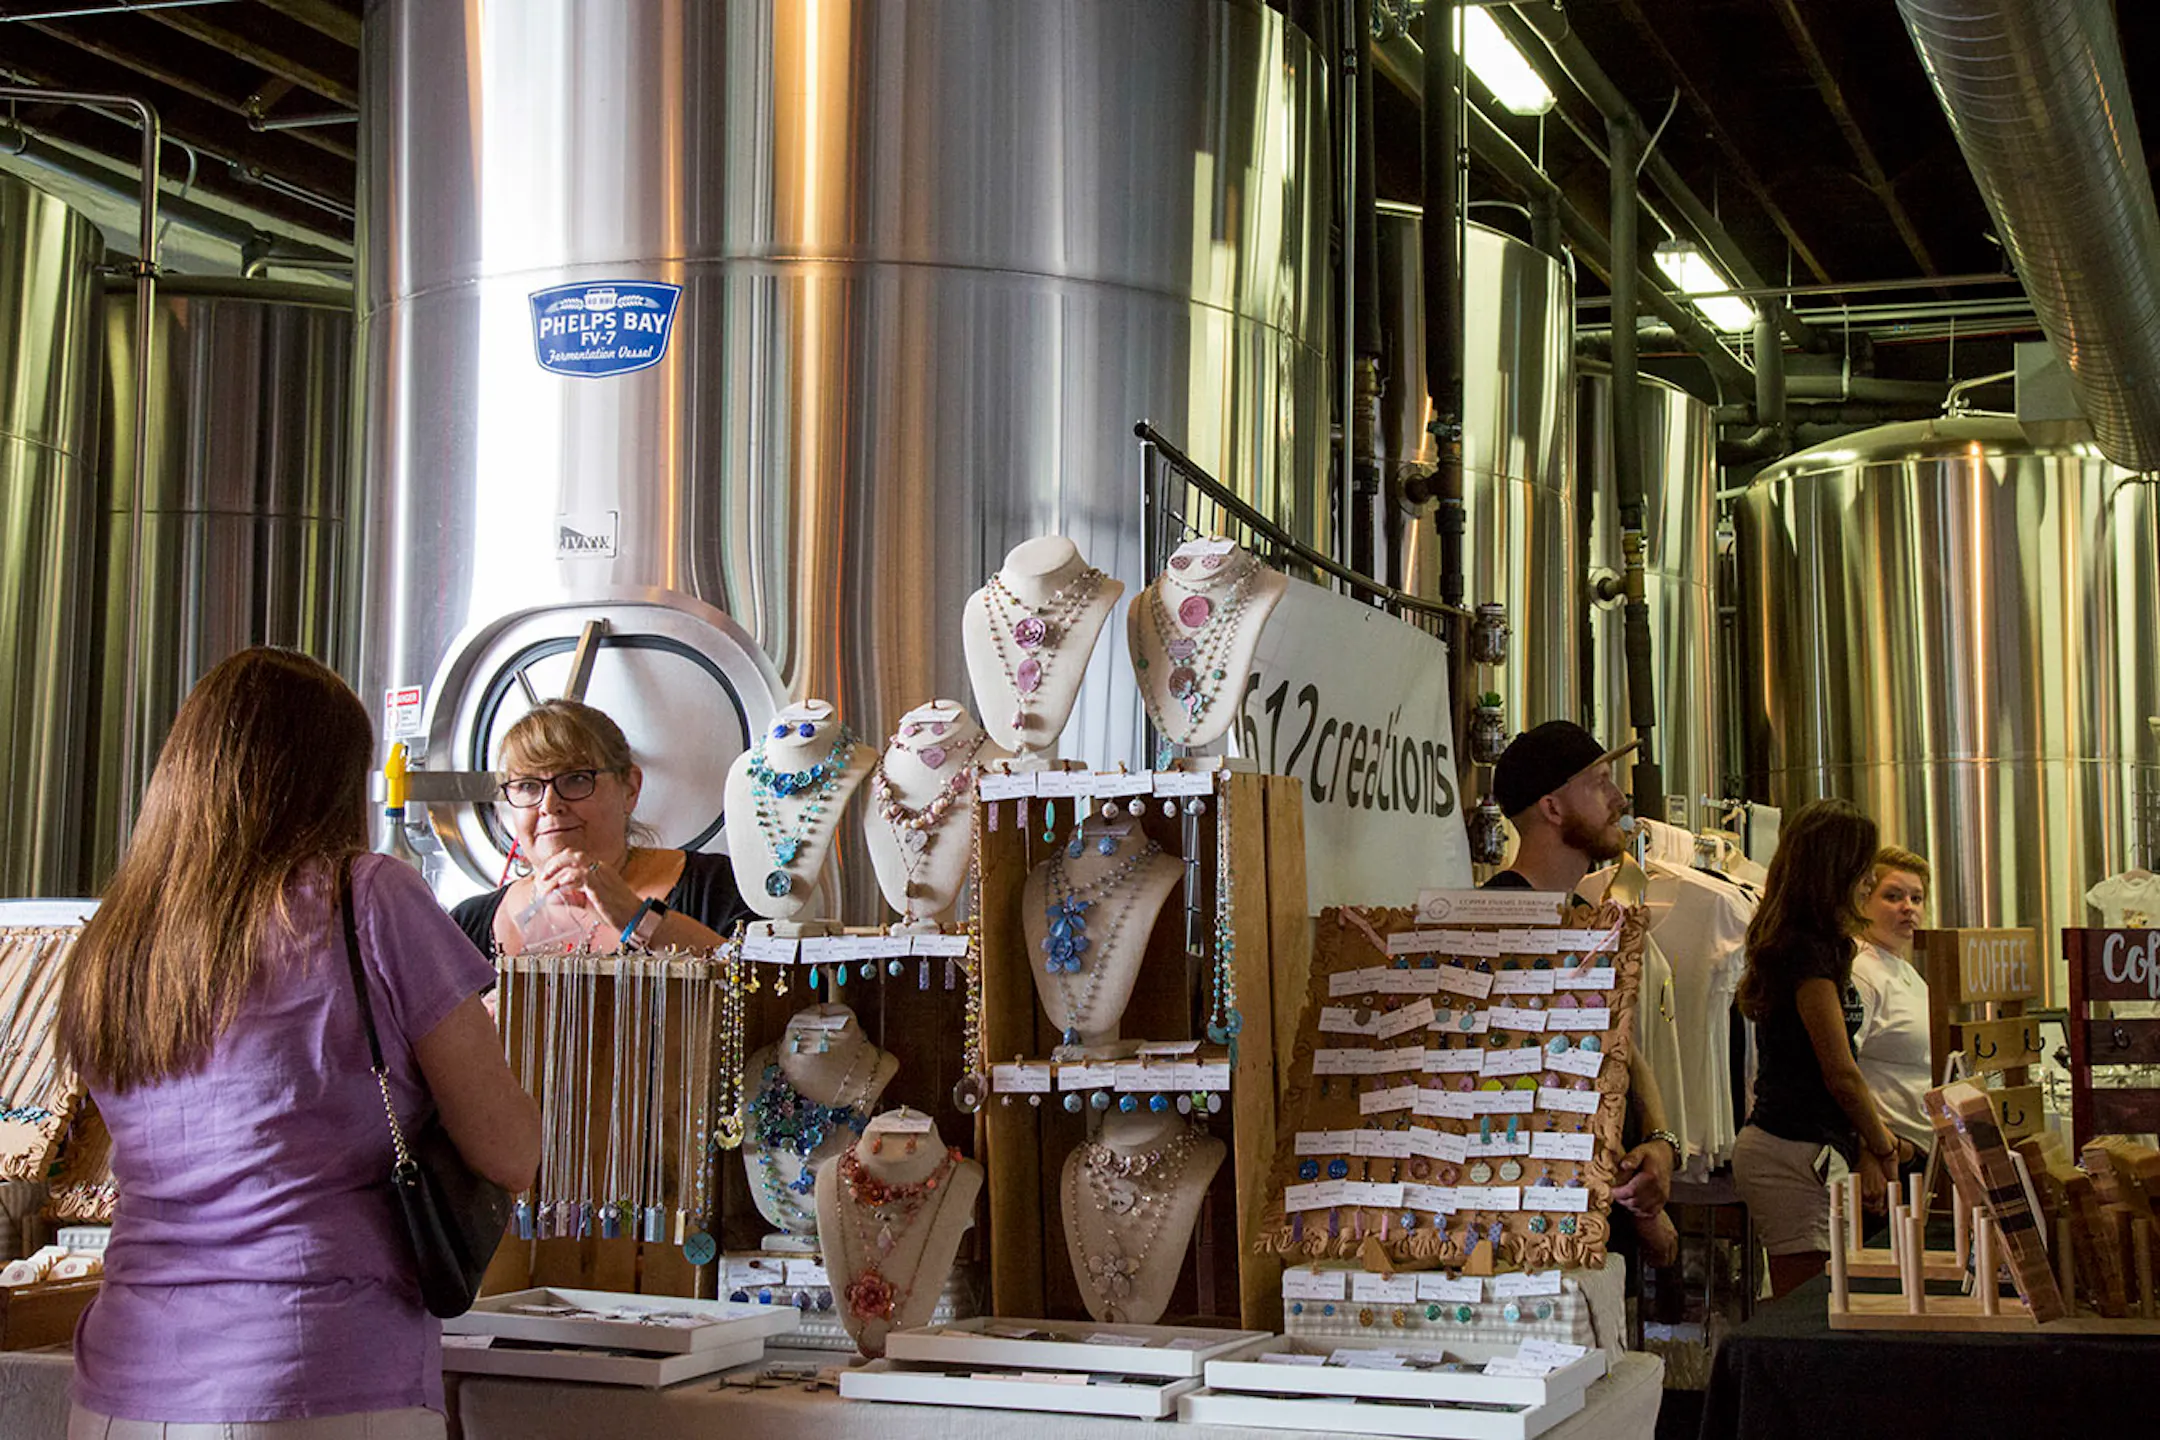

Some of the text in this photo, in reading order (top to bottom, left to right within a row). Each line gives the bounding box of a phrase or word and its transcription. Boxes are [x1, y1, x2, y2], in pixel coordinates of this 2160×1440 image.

[539, 311, 667, 339] PHELPS BAY
[580, 330, 616, 347] FV-7
[546, 345, 653, 364] Fermentation Vessel
[1967, 937, 2032, 994] COFFEE
